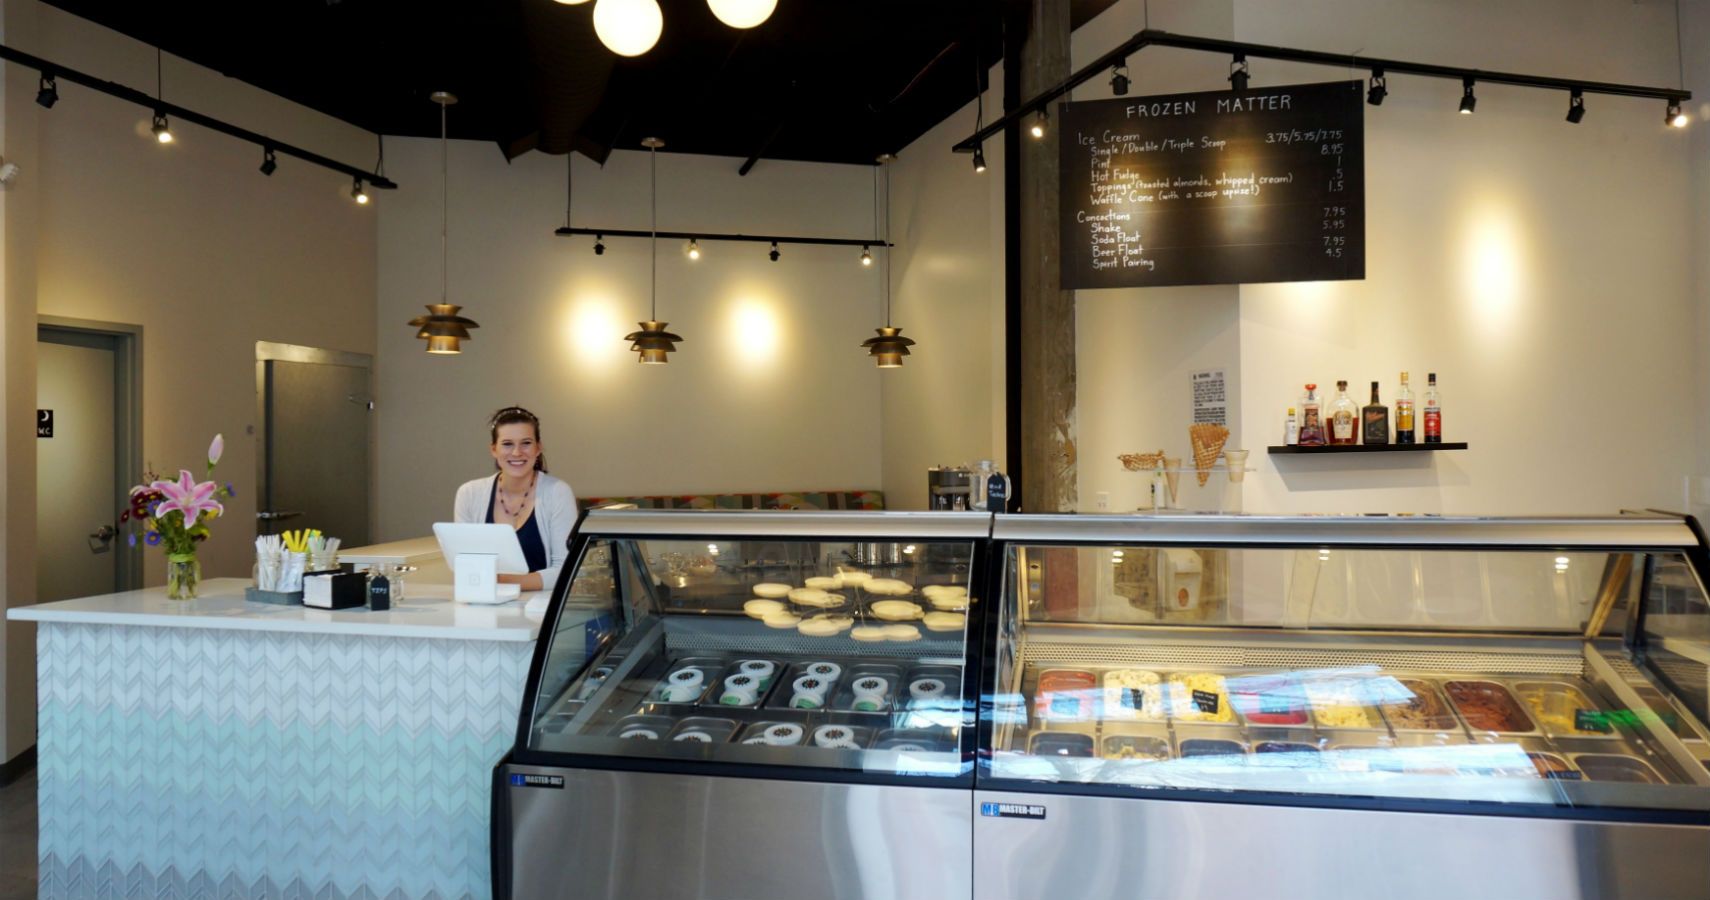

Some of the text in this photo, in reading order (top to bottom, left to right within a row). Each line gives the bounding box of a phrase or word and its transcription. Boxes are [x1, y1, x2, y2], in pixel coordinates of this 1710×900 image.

[1126, 94, 1292, 118] FROZEN MATTER
[1078, 130, 1140, 145] Ice Cream
[1201, 136, 1226, 150] Scoop
[1320, 143, 1344, 155] 8.95
[1091, 157, 1111, 168] Pint
[1091, 168, 1140, 184] Hot Fudge
[1090, 182, 1132, 196] Toppings
[1215, 172, 1255, 188] whipped
[1259, 172, 1293, 184] cream)
[1328, 180, 1344, 192] 1.5
[1090, 191, 1122, 205] Waffle
[1128, 190, 1154, 202] Cone
[1158, 189, 1180, 202] (with
[1186, 191, 1192, 199] a
[1195, 189, 1218, 199] scoop
[1323, 206, 1346, 217] 7.95
[1090, 221, 1121, 233] Shake
[1322, 220, 1345, 230] 5.95
[1091, 230, 1141, 245] Soda Float
[1322, 236, 1345, 246] 7.95
[1092, 243, 1144, 257] Beer Float
[1325, 248, 1342, 258] 4.5
[1092, 256, 1155, 271] Spirit Pairing
